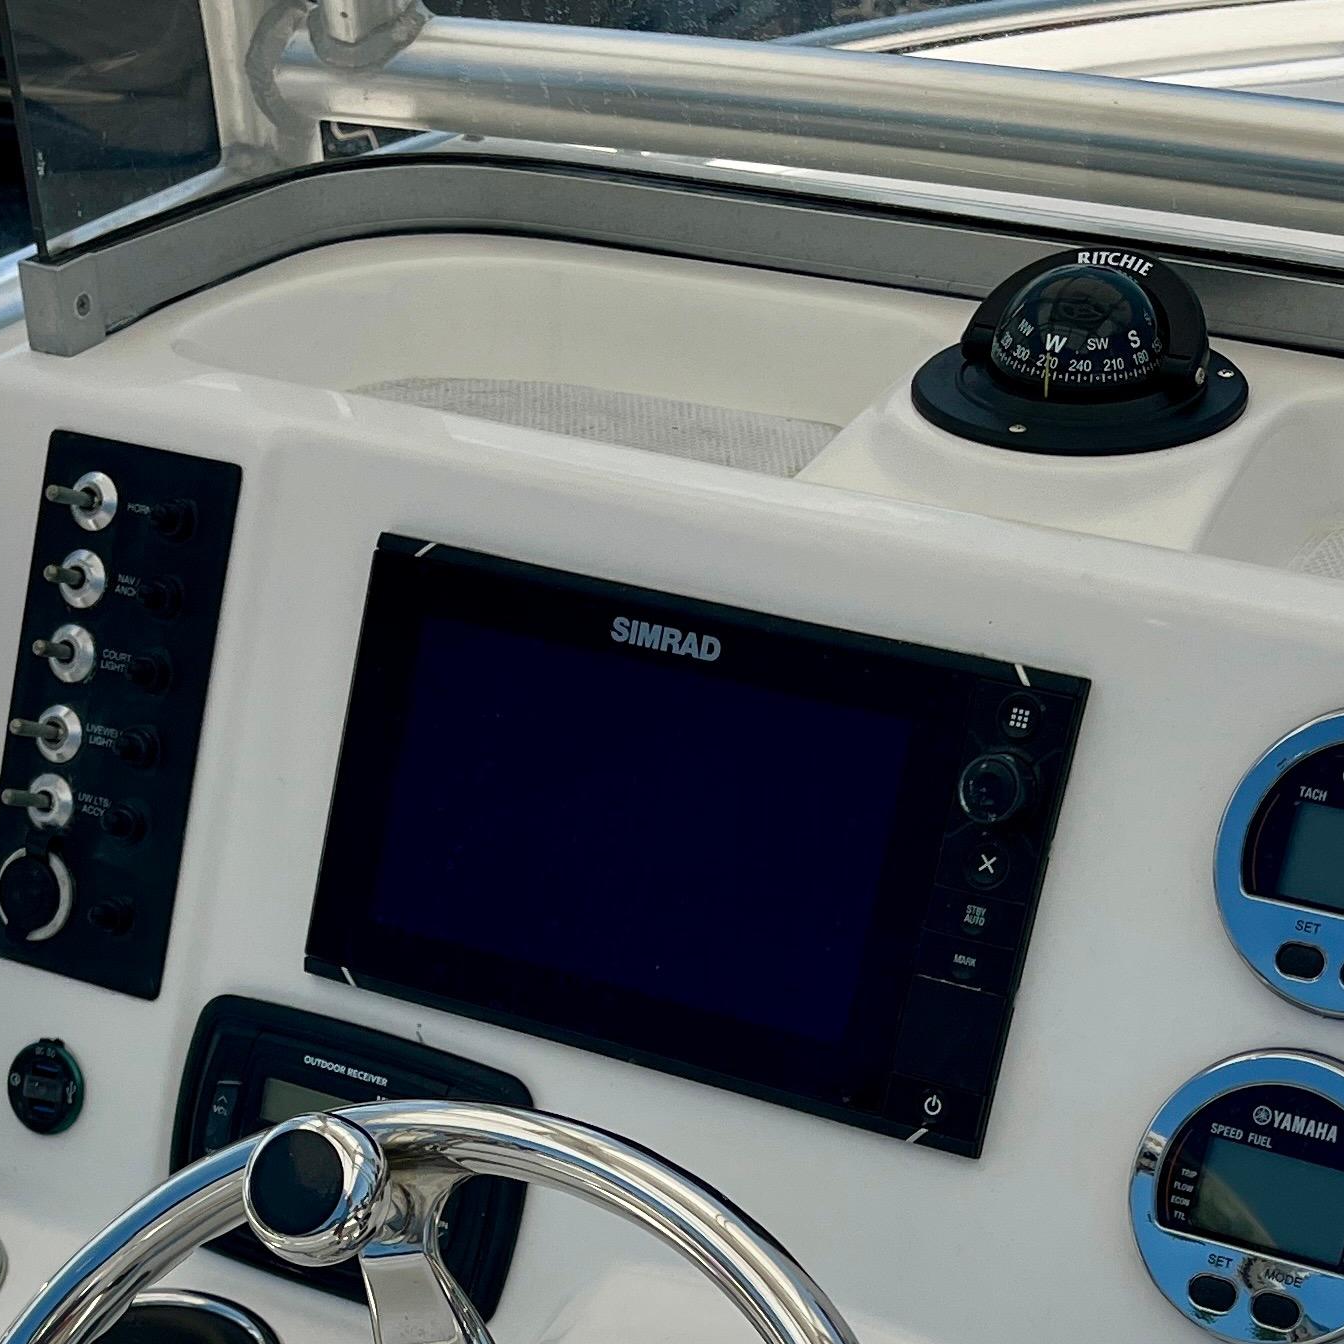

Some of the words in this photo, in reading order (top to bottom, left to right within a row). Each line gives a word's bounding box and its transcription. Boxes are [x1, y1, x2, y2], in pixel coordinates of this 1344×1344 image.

[1077, 251, 1154, 277] RITCHIE
[1045, 333, 1068, 353] W
[1086, 337, 1109, 351] SW
[1127, 329, 1141, 349] S
[1012, 344, 1030, 361] 300
[1036, 354, 1059, 369] 270
[1068, 360, 1092, 371] 240
[1103, 357, 1125, 371] 210
[1132, 349, 1149, 366] 180
[610, 616, 721, 661] SIMRAD
[102, 649, 133, 663] COURT
[1299, 786, 1328, 802] TACH
[81, 803, 106, 817] ACCY
[963, 914, 986, 927] AUTO
[966, 904, 987, 917] STBY
[1295, 920, 1321, 934] SET
[953, 954, 977, 967] MARK
[303, 1055, 346, 1076] OUTDOOR
[346, 1067, 388, 1087] RECEIVER
[1210, 1122, 1244, 1141] SPEED
[1247, 1132, 1273, 1149] FUEL
[1273, 1110, 1338, 1144] YAMAHA
[1173, 1181, 1194, 1193] FLOW
[1207, 1254, 1233, 1269] SET
[1264, 1268, 1304, 1288] MODE
